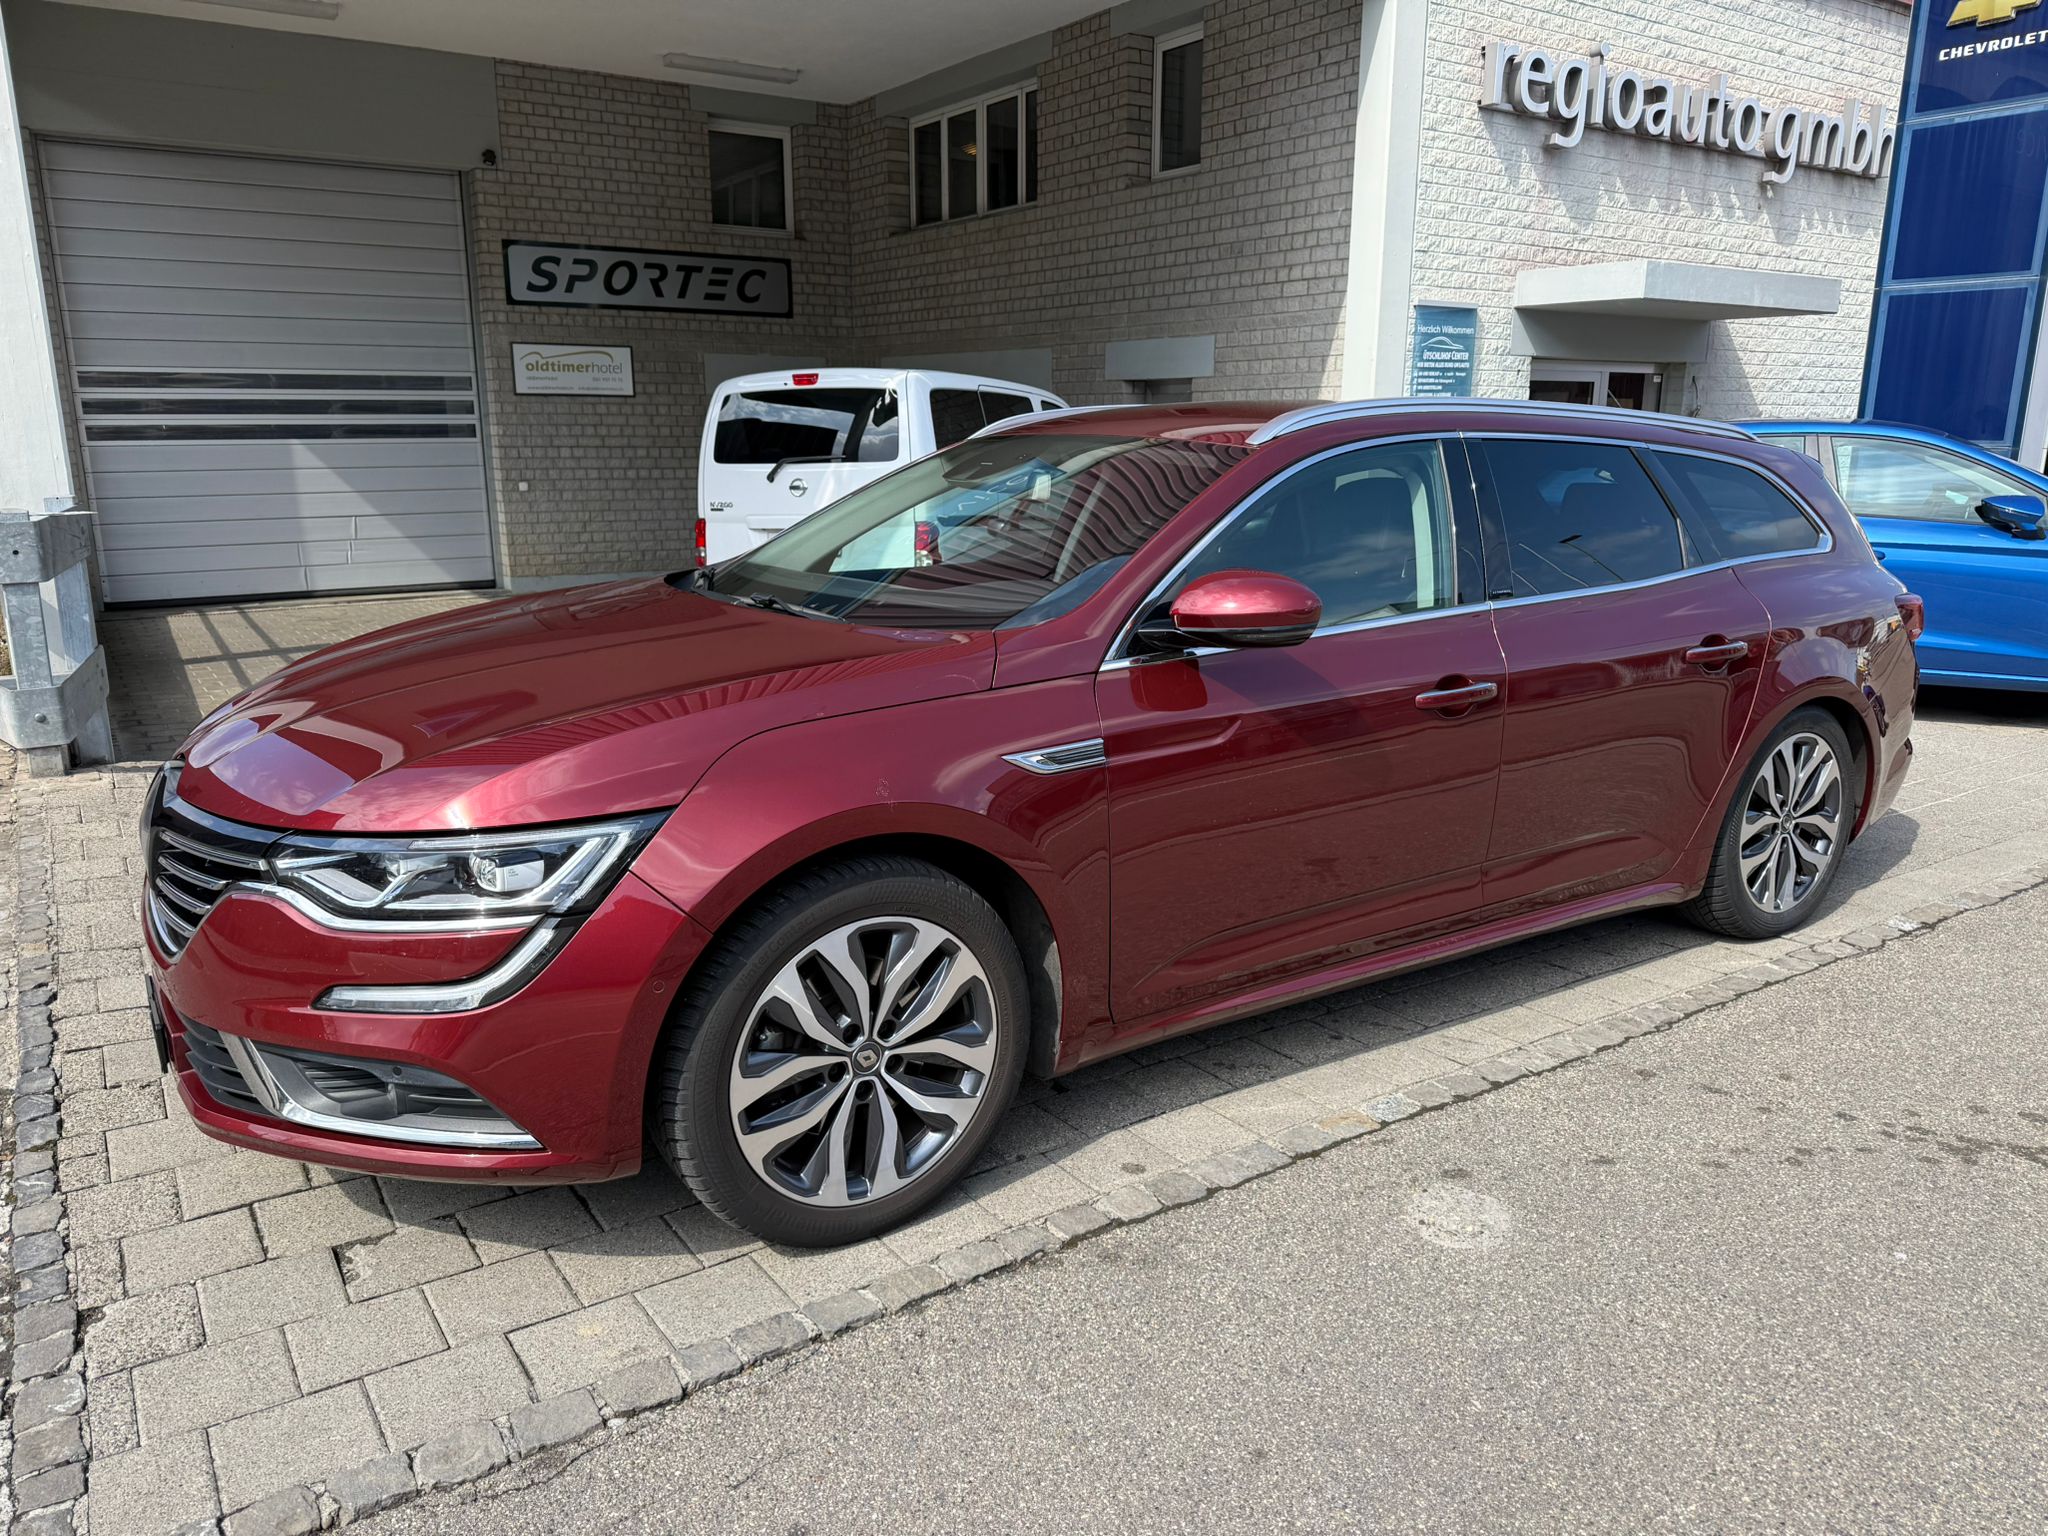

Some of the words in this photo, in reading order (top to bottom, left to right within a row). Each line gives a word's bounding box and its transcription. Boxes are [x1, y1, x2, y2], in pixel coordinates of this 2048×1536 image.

[1939, 29, 2048, 61] CHEVROLET
[526, 255, 767, 304] SPORTEC
[1417, 324, 1441, 334] Herzlich
[1442, 325, 1474, 334] Willkommen
[1452, 351, 1469, 361] CENTER
[525, 360, 623, 374] oldtimerhotel
